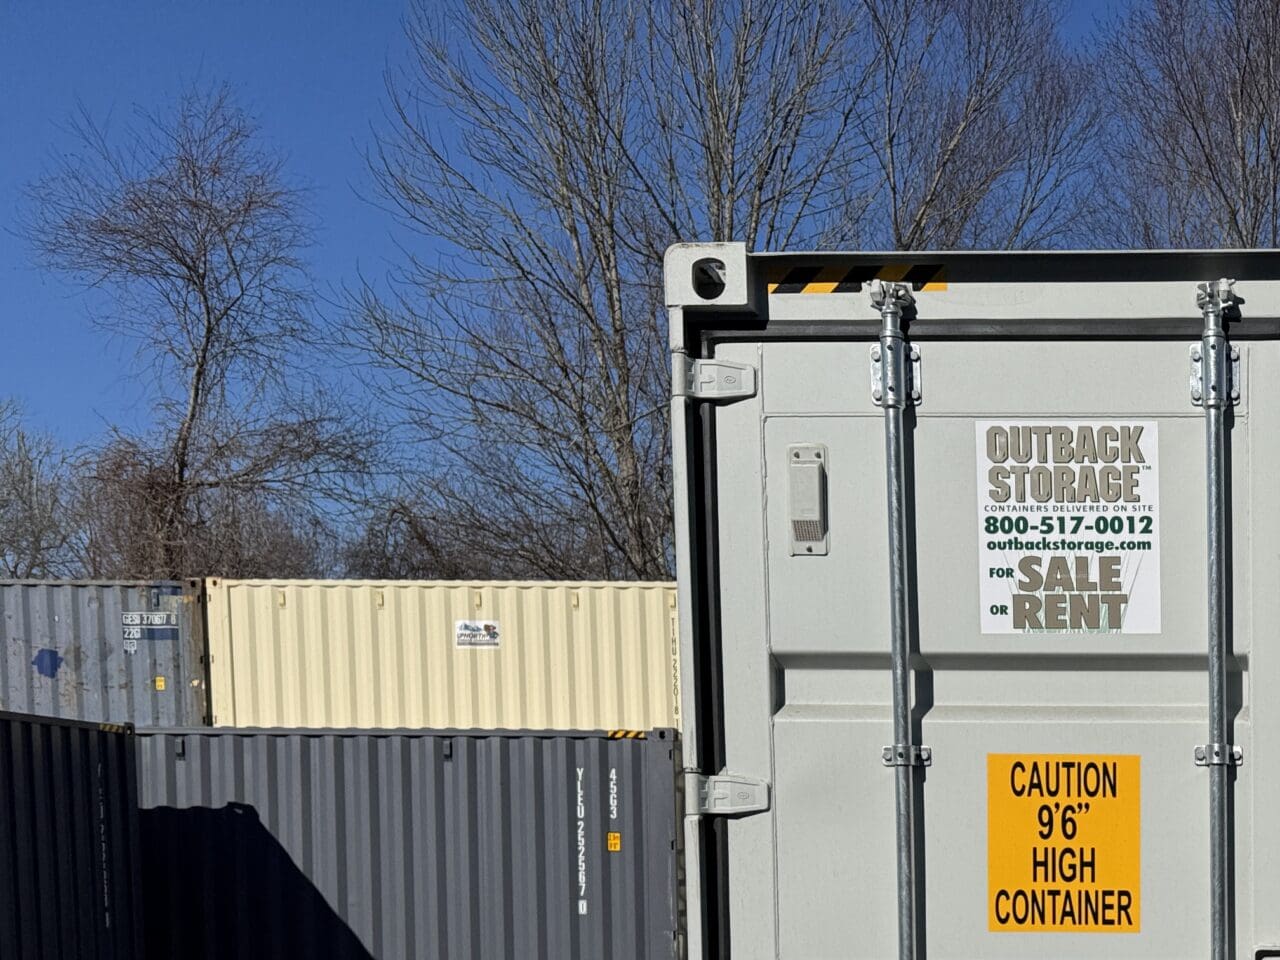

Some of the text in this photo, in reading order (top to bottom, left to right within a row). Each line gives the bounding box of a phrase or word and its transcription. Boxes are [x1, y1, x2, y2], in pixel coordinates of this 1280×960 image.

[986, 426, 1146, 464] OUTBACK
[988, 465, 1140, 503] STORAGE
[984, 516, 1153, 535] 800-517-0012
[1132, 504, 1154, 512] SITE
[986, 537, 1152, 553] outbackstorage.com
[989, 556, 1122, 592] FOR SALE
[989, 594, 1128, 629] OR RENT
[1010, 761, 1117, 798] CAUTION
[1032, 847, 1096, 883] HIGH
[994, 889, 1133, 925] CONTAINER
